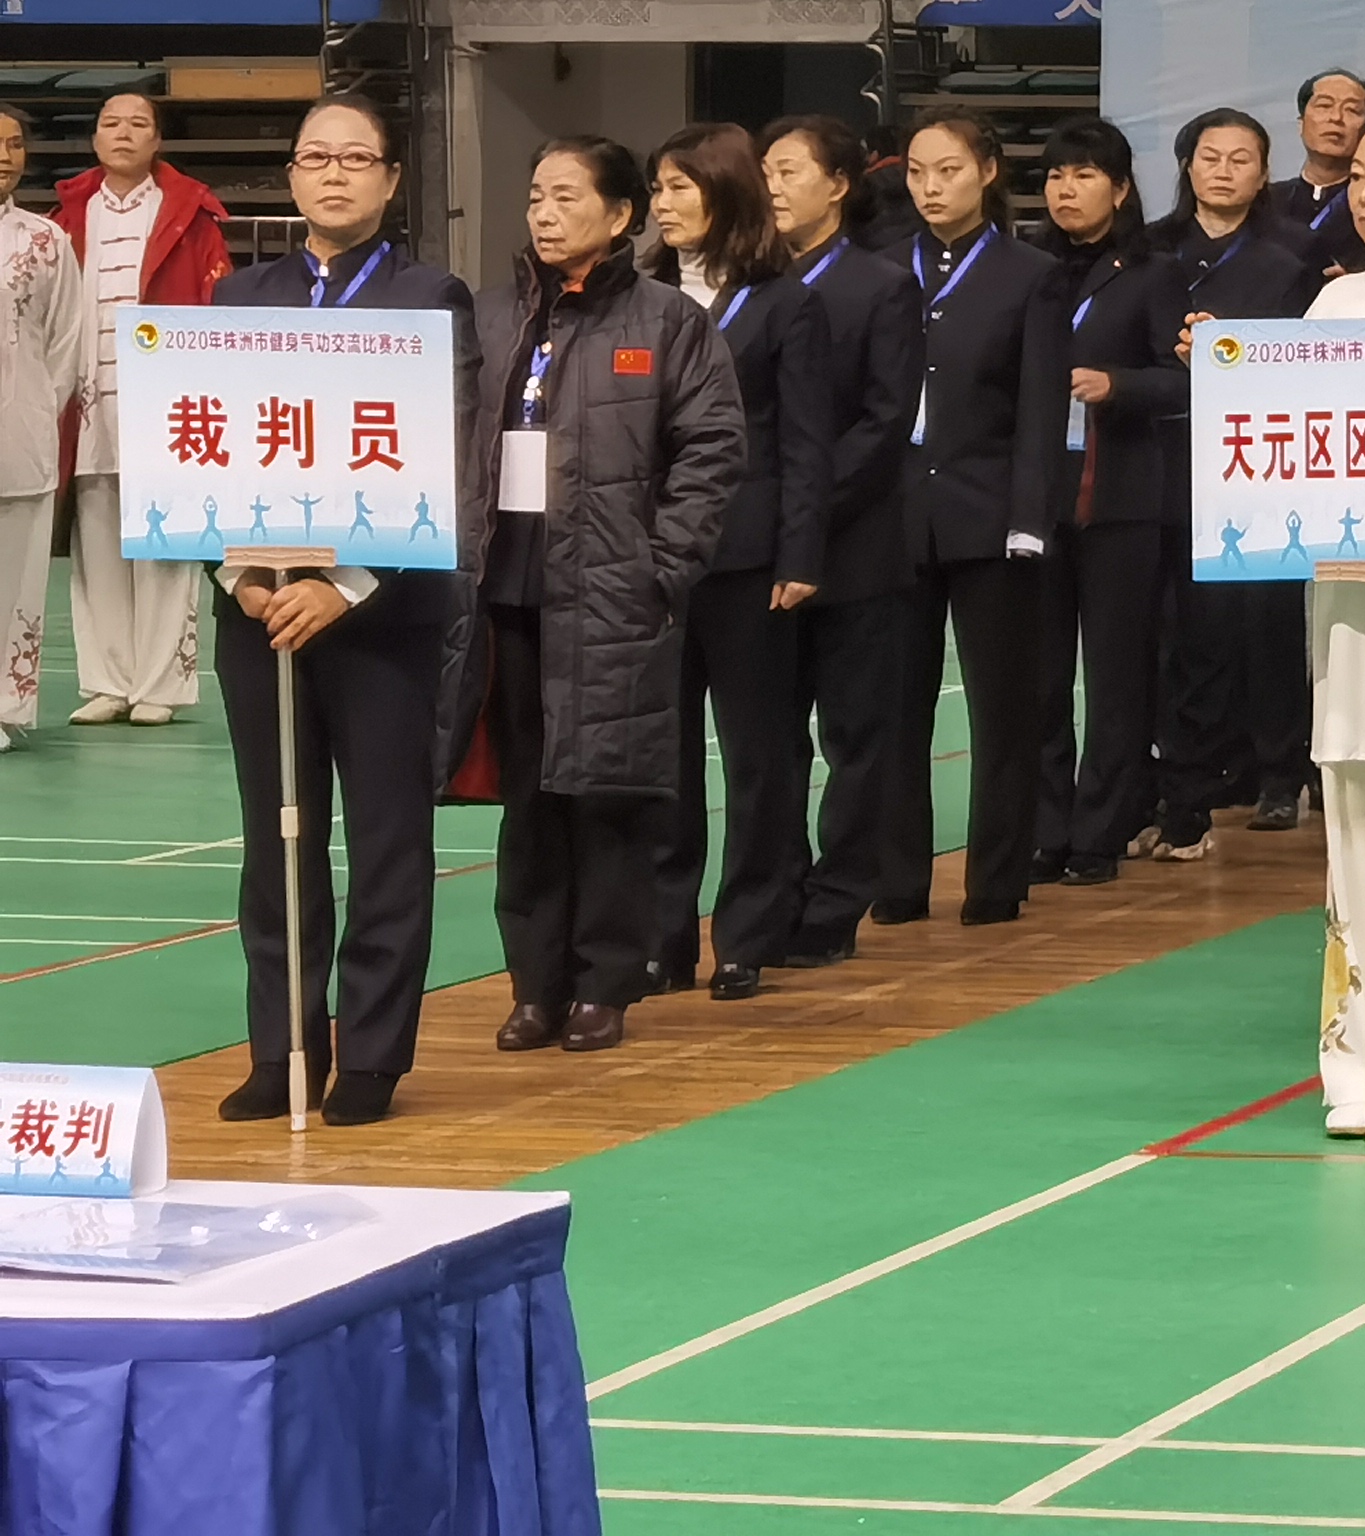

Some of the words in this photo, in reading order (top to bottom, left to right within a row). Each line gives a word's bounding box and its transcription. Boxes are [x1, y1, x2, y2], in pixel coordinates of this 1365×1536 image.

[165, 330, 424, 356] 2020年株洲市健身气功交流比赛大会
[167, 395, 405, 472] 裁判员
[0, 1098, 115, 1159] 裁判
